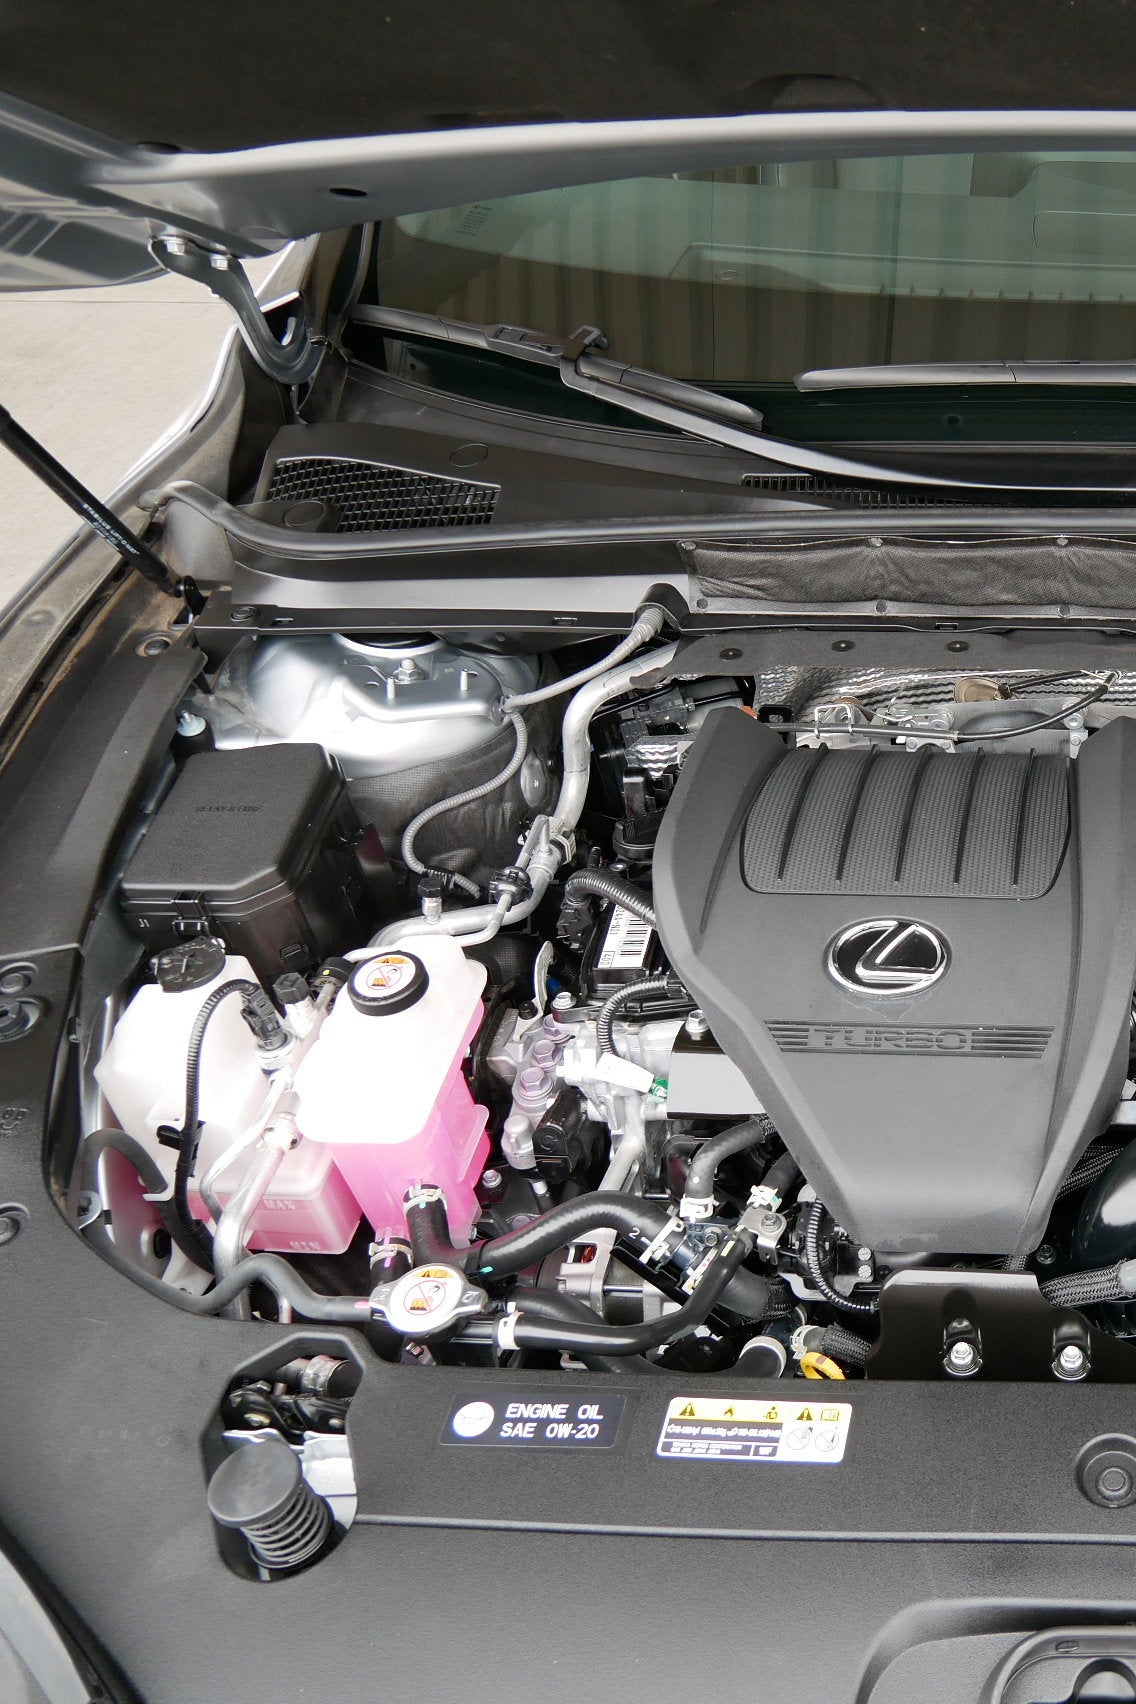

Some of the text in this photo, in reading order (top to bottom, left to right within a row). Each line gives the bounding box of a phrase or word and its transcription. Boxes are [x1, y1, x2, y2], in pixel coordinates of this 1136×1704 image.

[814, 1028, 968, 1050] TURBO
[263, 1200, 297, 1211] MAX
[289, 1240, 319, 1251] MIN
[505, 1403, 604, 1420] ENGINE OIL
[499, 1422, 600, 1439] SAE 0W-20
